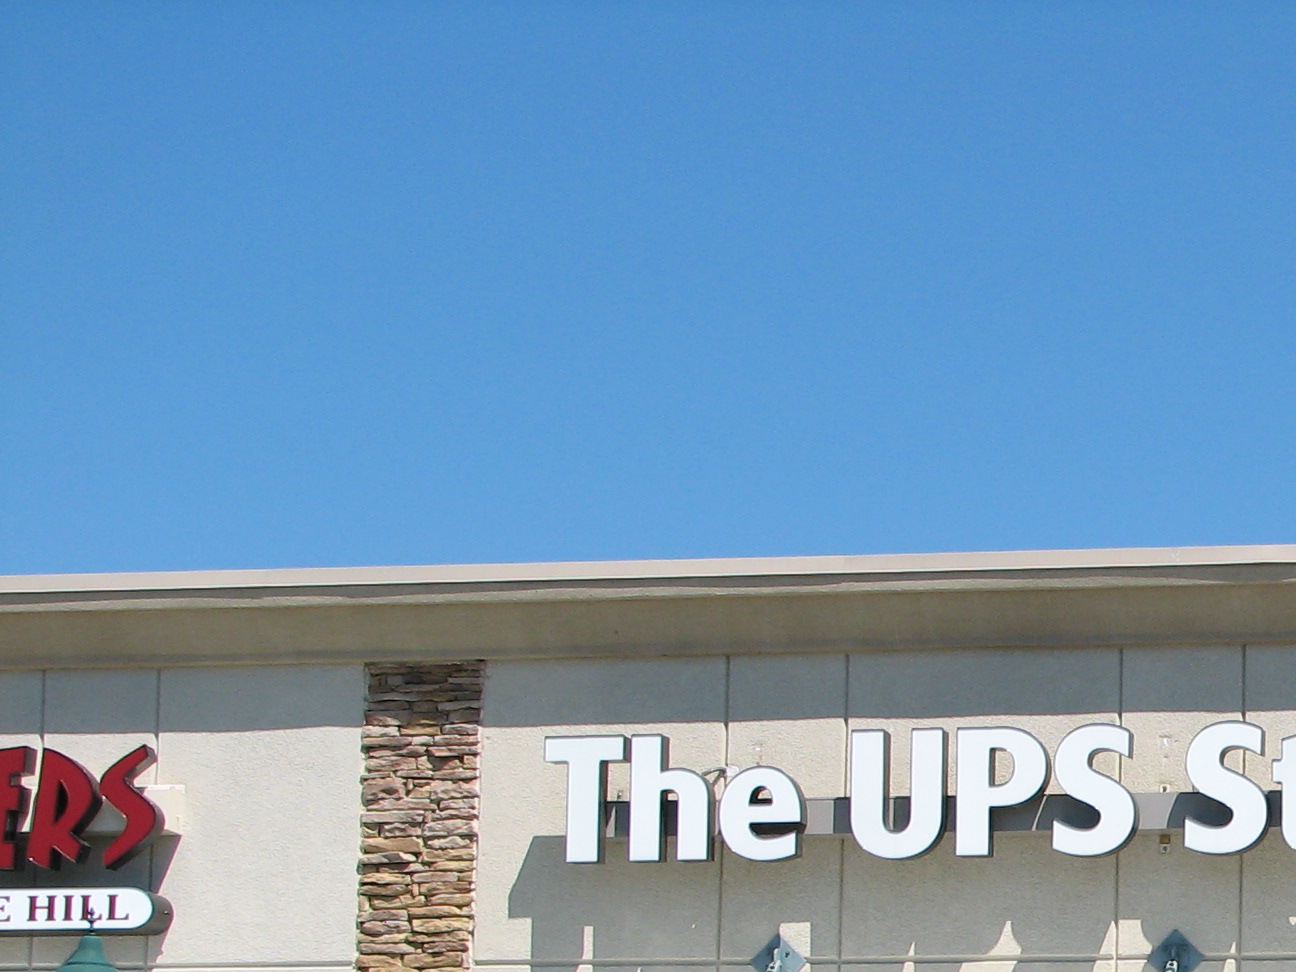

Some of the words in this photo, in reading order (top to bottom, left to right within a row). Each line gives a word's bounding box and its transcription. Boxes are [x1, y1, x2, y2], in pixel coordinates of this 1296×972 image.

[545, 733, 802, 863] The
[850, 723, 1136, 859] UPS
[26, 894, 130, 922] HILL
